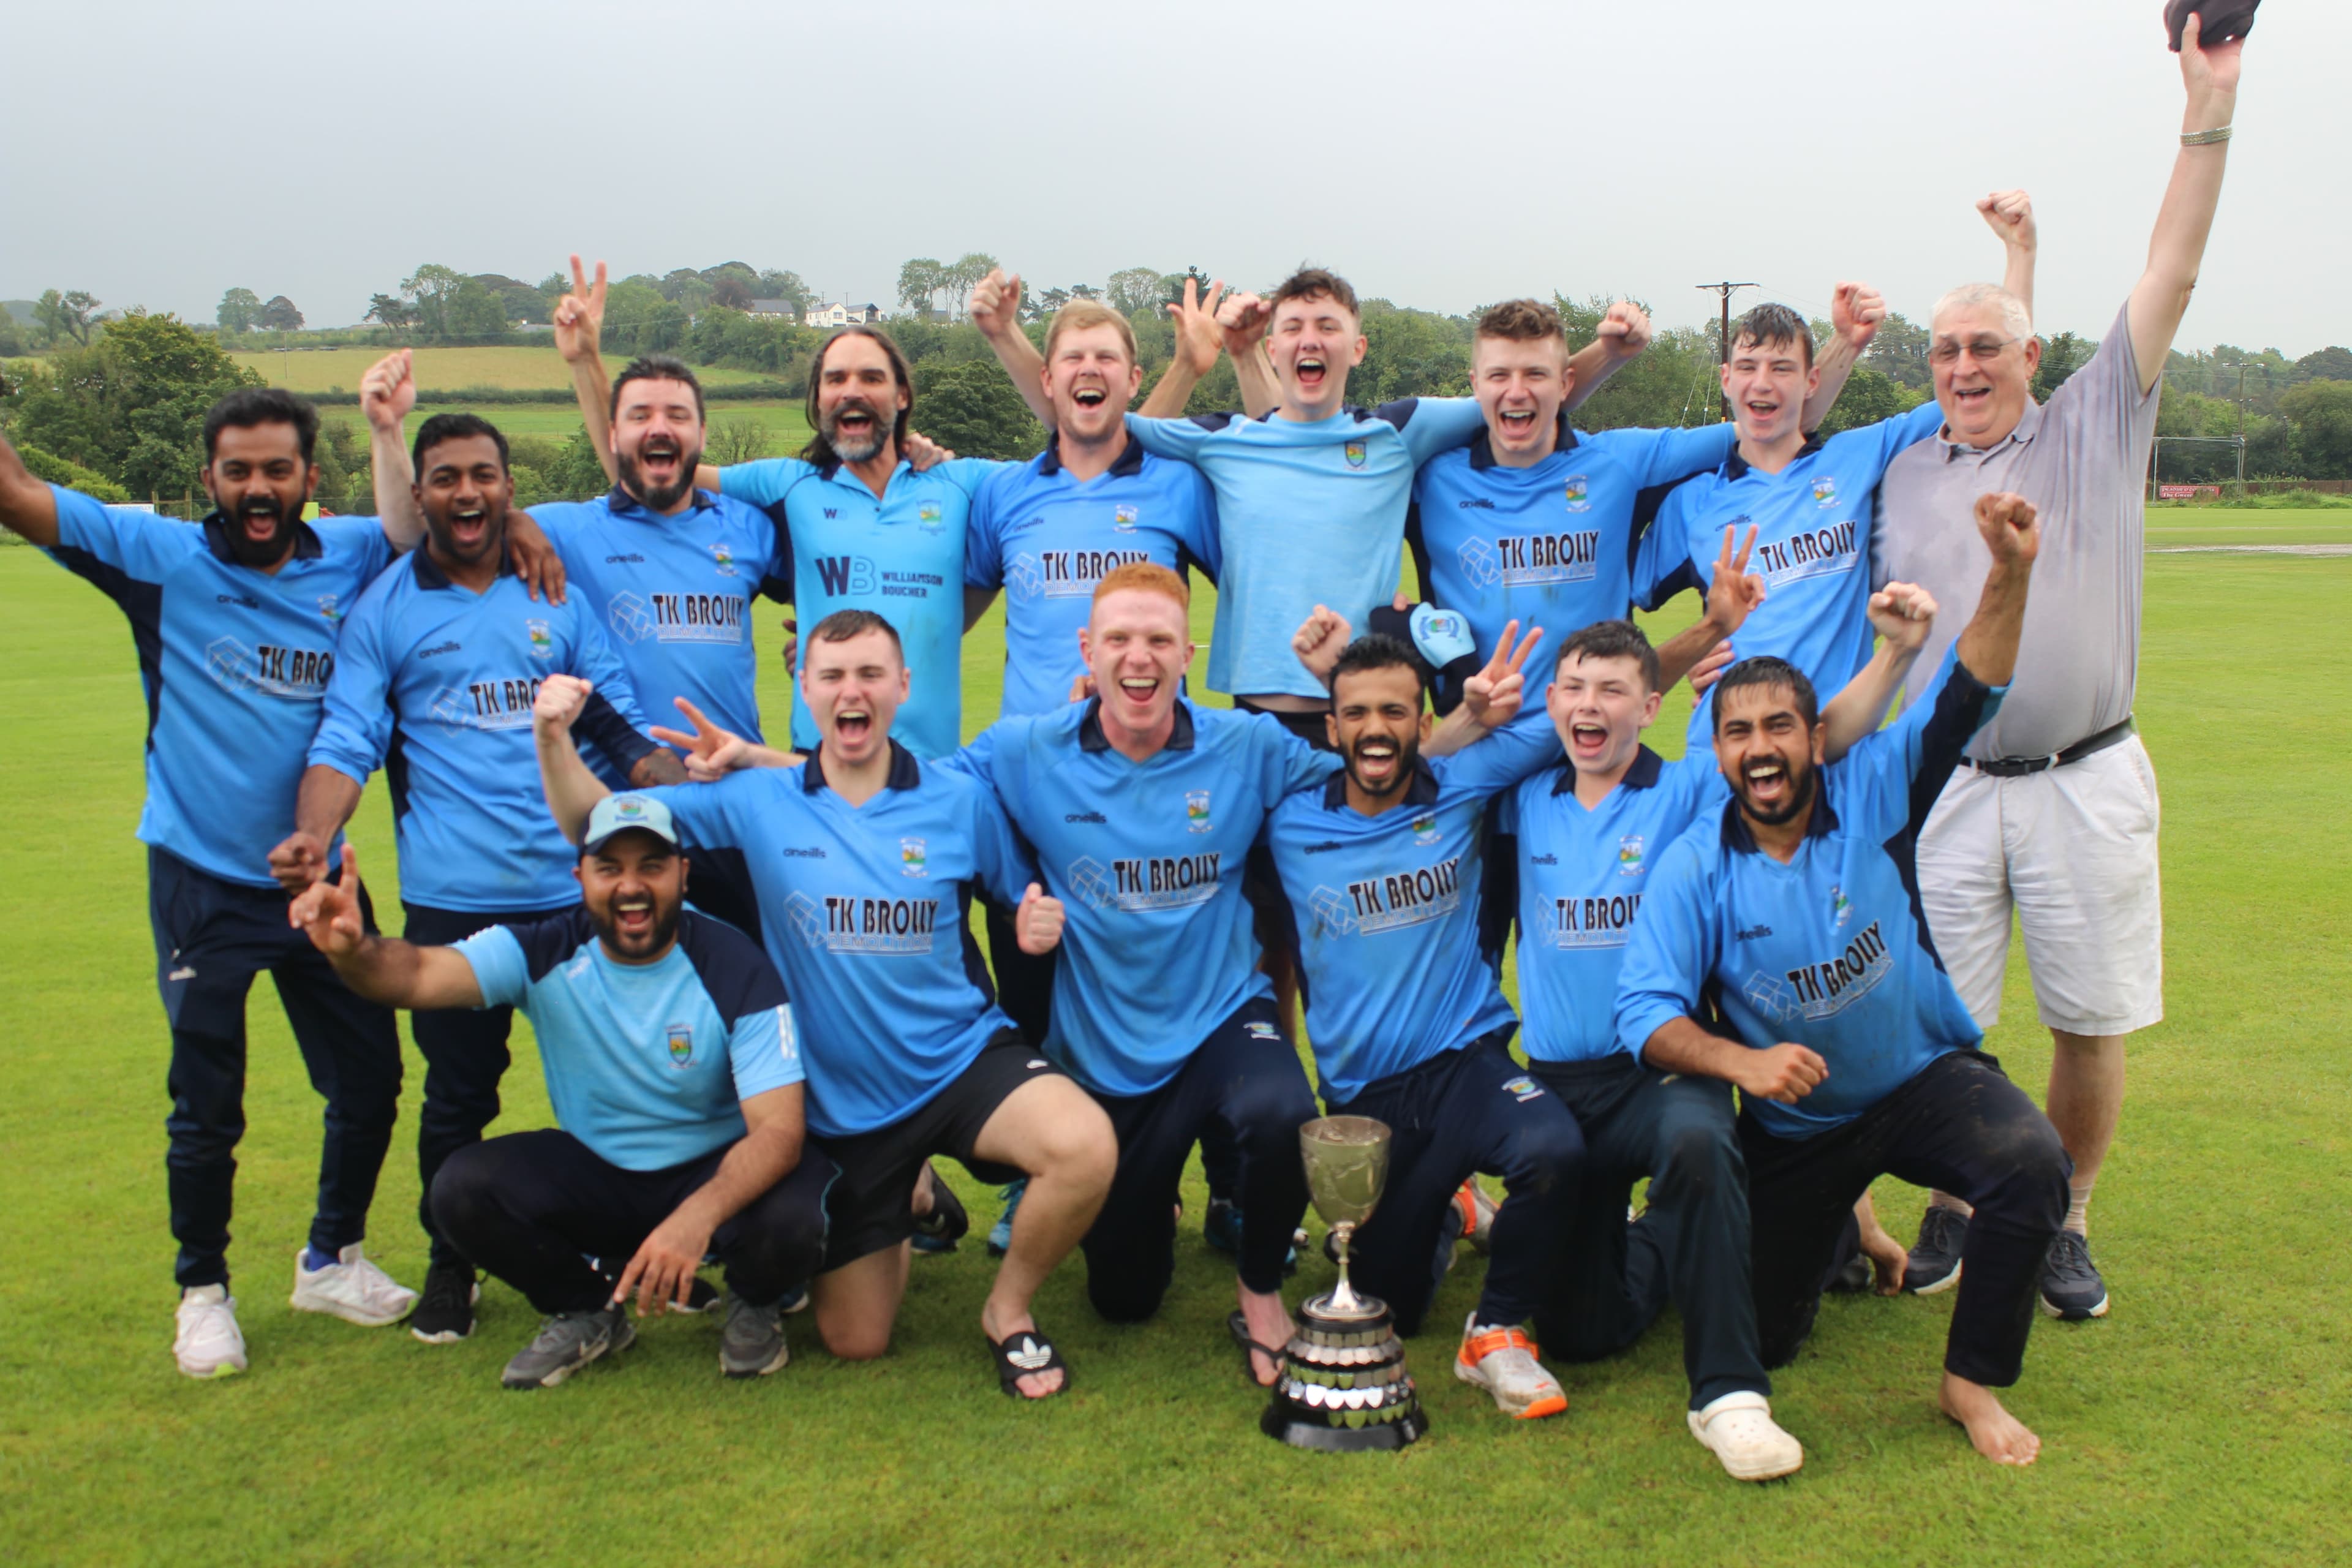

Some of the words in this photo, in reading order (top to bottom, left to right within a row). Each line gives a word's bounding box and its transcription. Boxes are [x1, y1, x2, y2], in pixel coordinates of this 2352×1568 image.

[1042, 551, 1069, 581] TK
[1498, 537, 1526, 570] TK
[1758, 541, 1790, 573] TK
[881, 571, 944, 587] WILLIAMSON
[881, 585, 928, 598] BOUCHER
[652, 594, 681, 625] TK
[258, 645, 288, 682] TK
[292, 649, 335, 686] BRO
[469, 682, 501, 717] TK
[1113, 860, 1142, 894] TK
[1349, 880, 1389, 916] TK
[826, 897, 855, 933] TK
[1556, 899, 1578, 931] TK
[1788, 965, 1824, 1003] TK
